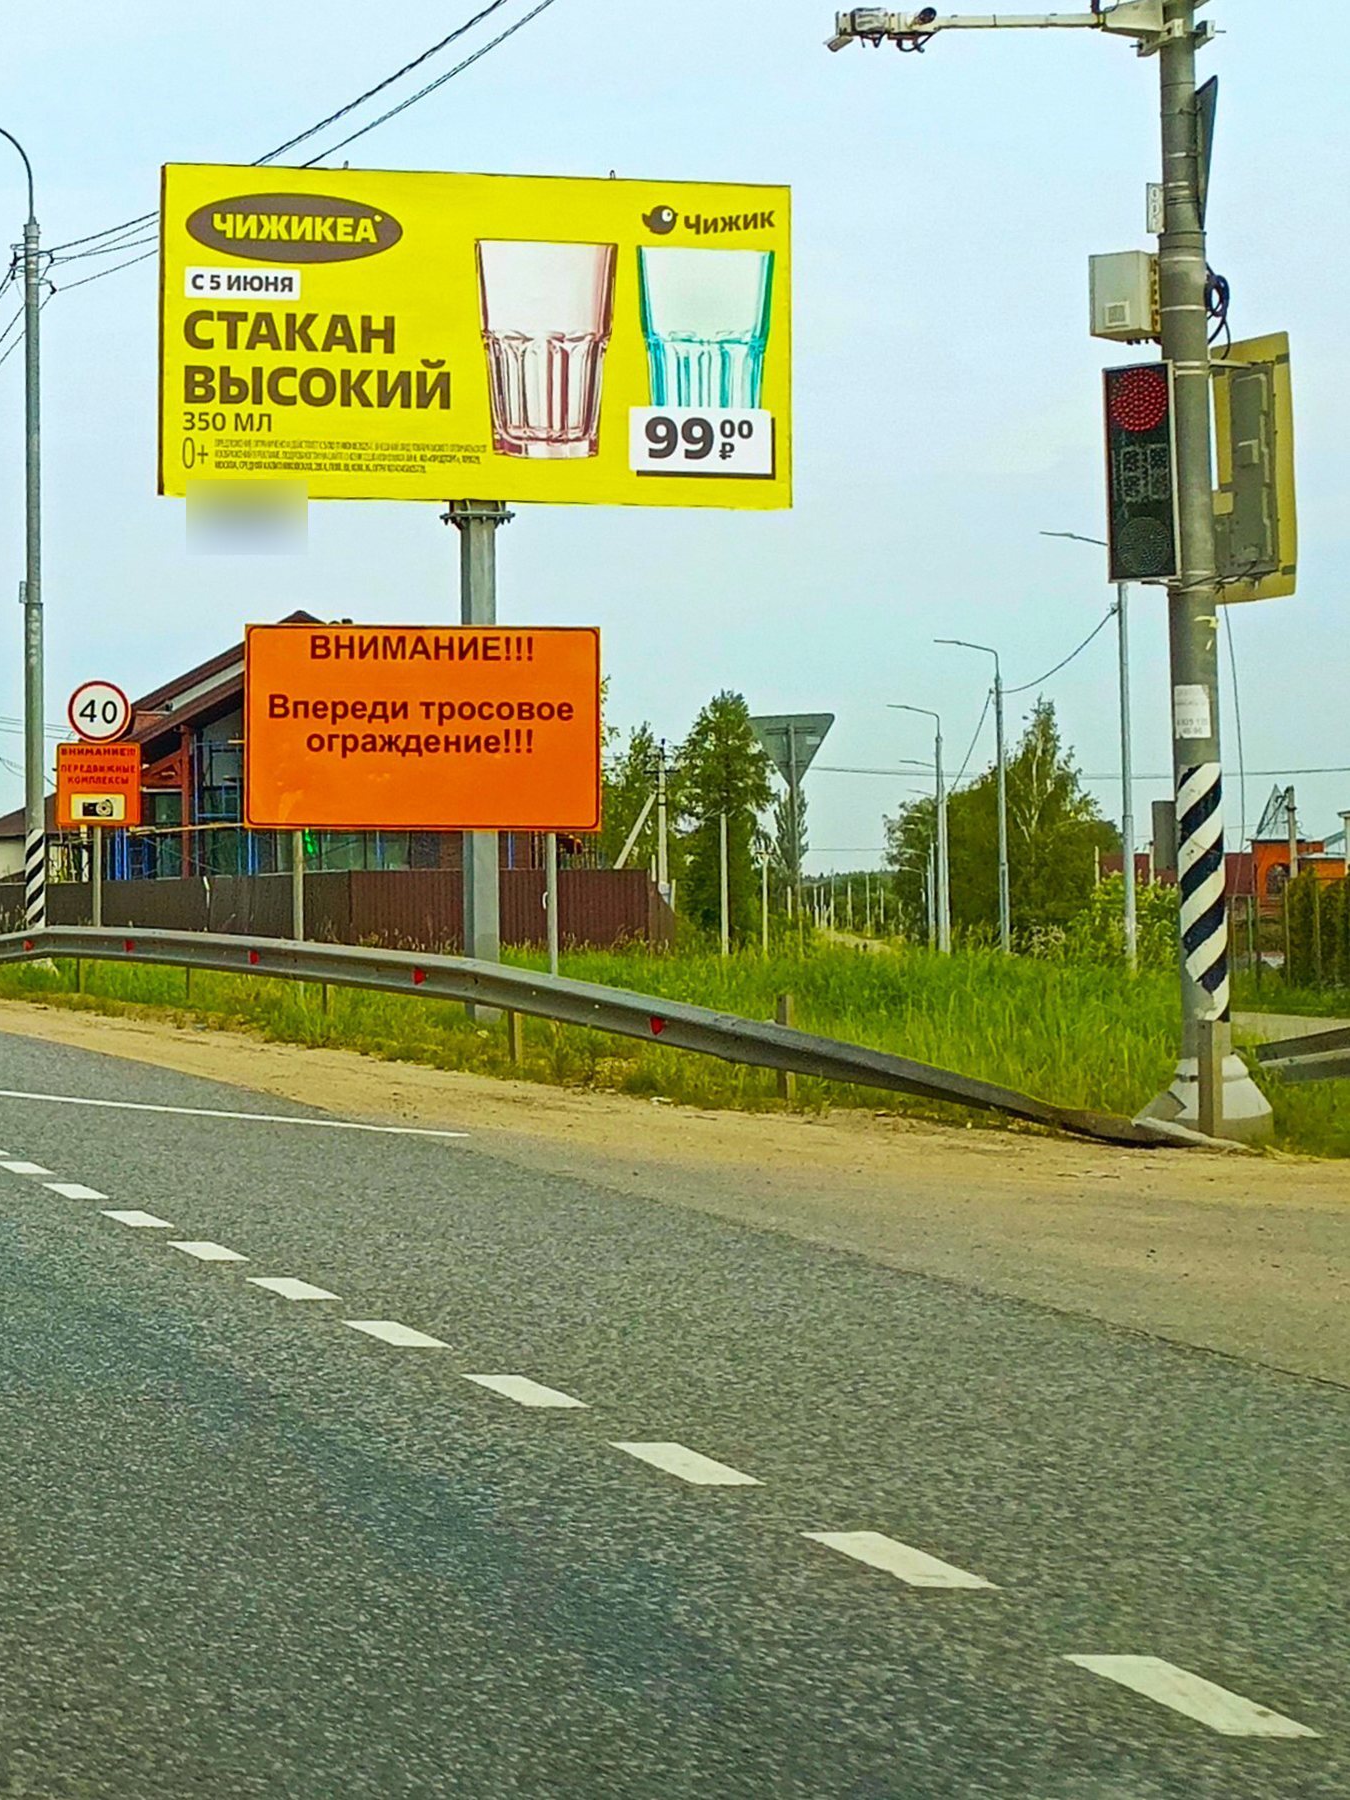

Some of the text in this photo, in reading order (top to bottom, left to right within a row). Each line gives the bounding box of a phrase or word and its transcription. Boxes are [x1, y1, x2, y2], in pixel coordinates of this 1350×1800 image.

[212, 212, 379, 243] ЧИЖИКЕА
[683, 210, 776, 236] Чижик
[191, 273, 294, 293] С 5 ИЮНЯ
[183, 309, 395, 355] СТАКАН
[183, 358, 451, 410] ВЫСОКИЙ
[182, 411, 272, 433] 350 МЛ
[644, 415, 715, 460] 99
[719, 418, 754, 439] 00
[181, 436, 209, 469] 0+
[309, 634, 535, 662] ВНИМАНИЕ!!!
[78, 699, 117, 724] 40
[267, 693, 575, 727] Впереди тросовое
[305, 728, 535, 759] ограждение!!!
[60, 764, 135, 773] ПЕРЕДВИЖНЫЕ
[67, 776, 129, 785] КОМПЛЕКСЫ
